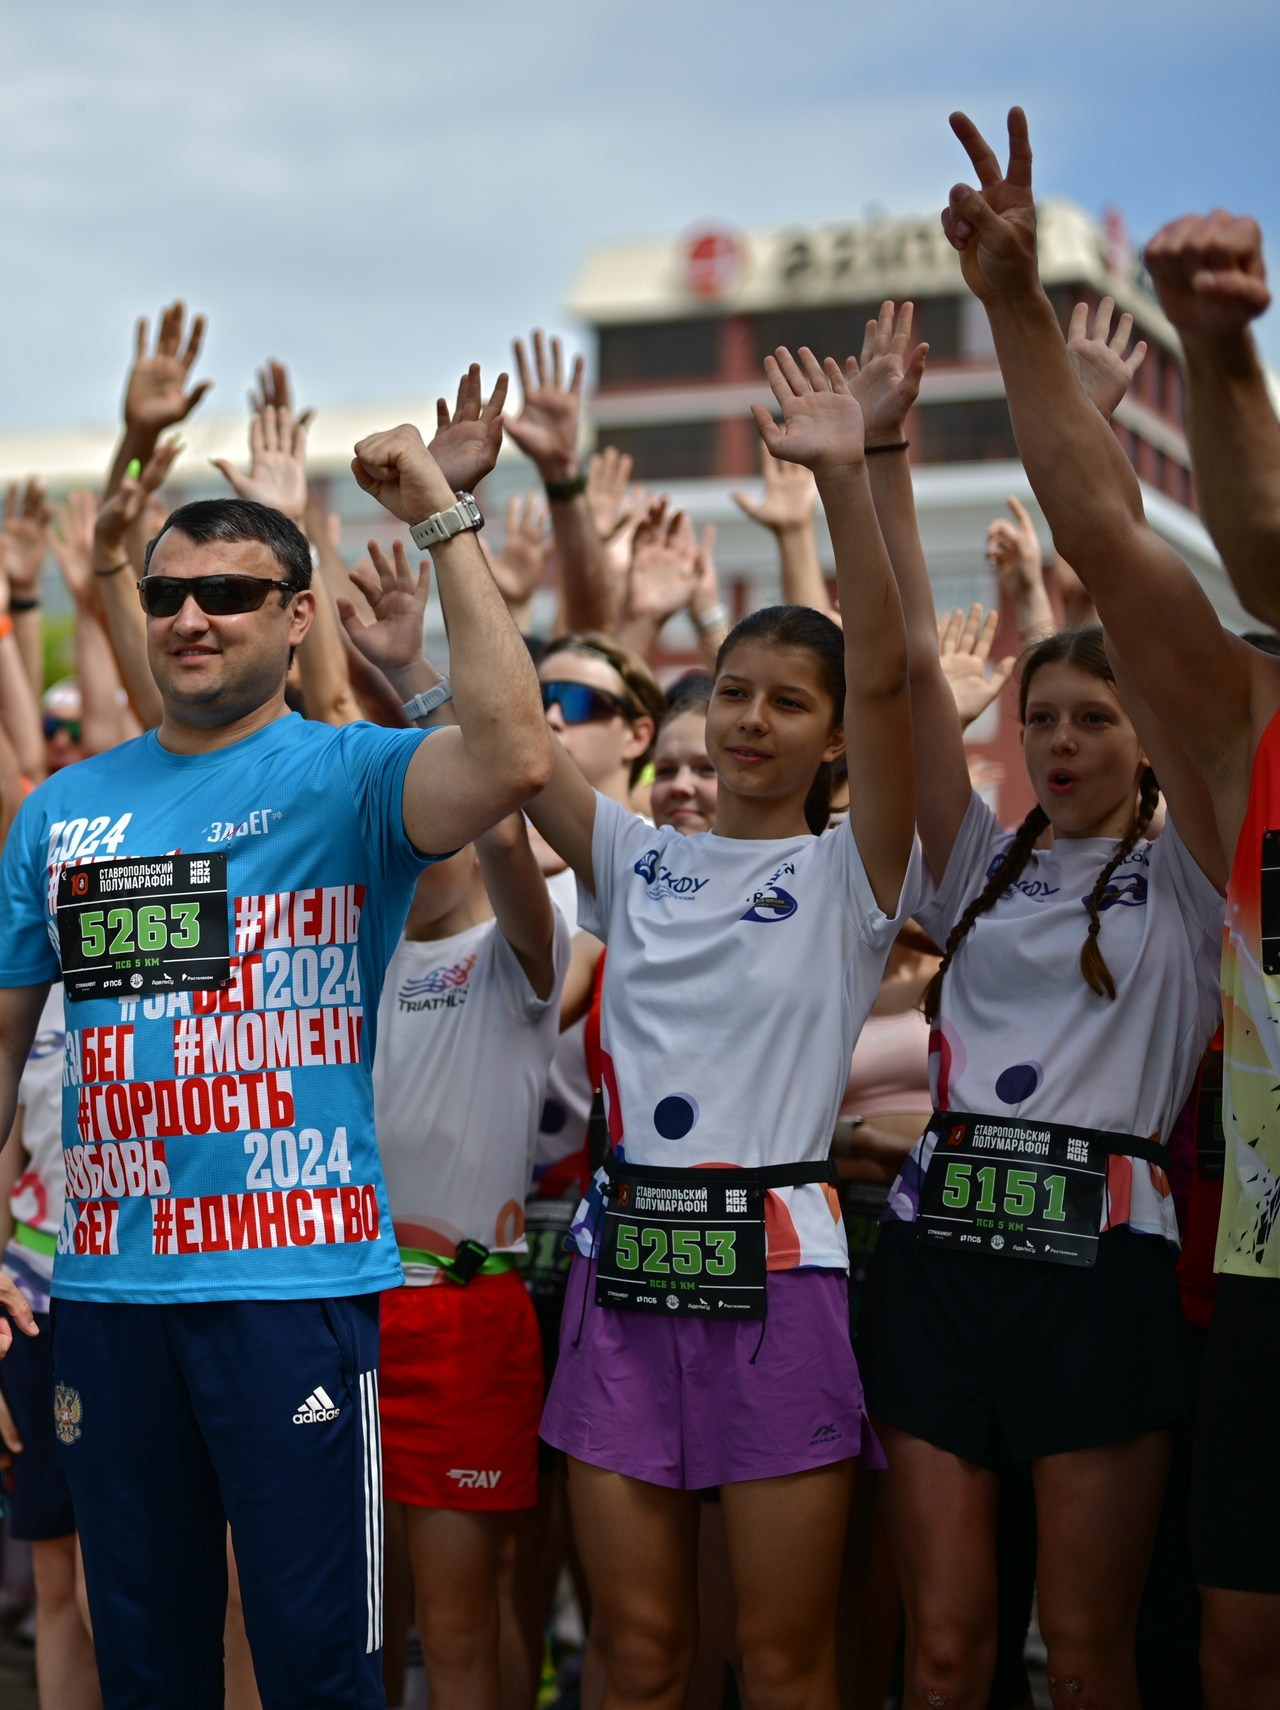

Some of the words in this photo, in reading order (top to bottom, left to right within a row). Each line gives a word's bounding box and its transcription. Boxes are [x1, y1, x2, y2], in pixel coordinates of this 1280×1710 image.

[47, 813, 132, 866] 2024
[100, 861, 173, 879] СТАВРОПОЛЬСКИЙ
[71, 873, 88, 896] 10
[100, 874, 173, 892] ПОЛУМАРАФОН
[190, 876, 210, 884] RUN
[235, 884, 361, 952] #ЦЕЛЬ
[80, 902, 200, 957] 5263
[115, 959, 131, 969] ПСБ
[135, 959, 141, 967] 5
[145, 957, 160, 967] КМ
[109, 979, 122, 987] ПСБ
[399, 996, 465, 1013] TRIATHL
[174, 1007, 363, 1076] #МОМЕНТ
[77, 1071, 295, 1142] #ГОРДОСТЬ
[974, 1124, 1051, 1143] СТАВРОПОЛЬСКИЙ
[972, 1135, 1050, 1155] ПОЛУМАРАФОН
[243, 1127, 352, 1190] 2024
[1067, 1154, 1088, 1163] RUN
[636, 1186, 708, 1200] СТАВРОПОЛЬСКИЙ
[942, 1163, 1066, 1221] 5151
[635, 1196, 708, 1213] ПОЛУМАРАФОН
[726, 1204, 747, 1213] RUN
[153, 1184, 381, 1255] #ЕДИНСТВО
[976, 1218, 994, 1228] ПСБ
[998, 1221, 1004, 1229] 5
[1008, 1222, 1024, 1232] КМ
[967, 1235, 982, 1243] ПСБ
[616, 1224, 737, 1276] 5253
[650, 1280, 667, 1288] ПСБ
[671, 1281, 677, 1289] 5
[680, 1282, 695, 1290] КМ
[643, 1296, 657, 1304] ПСБ
[292, 1408, 340, 1424] adidas
